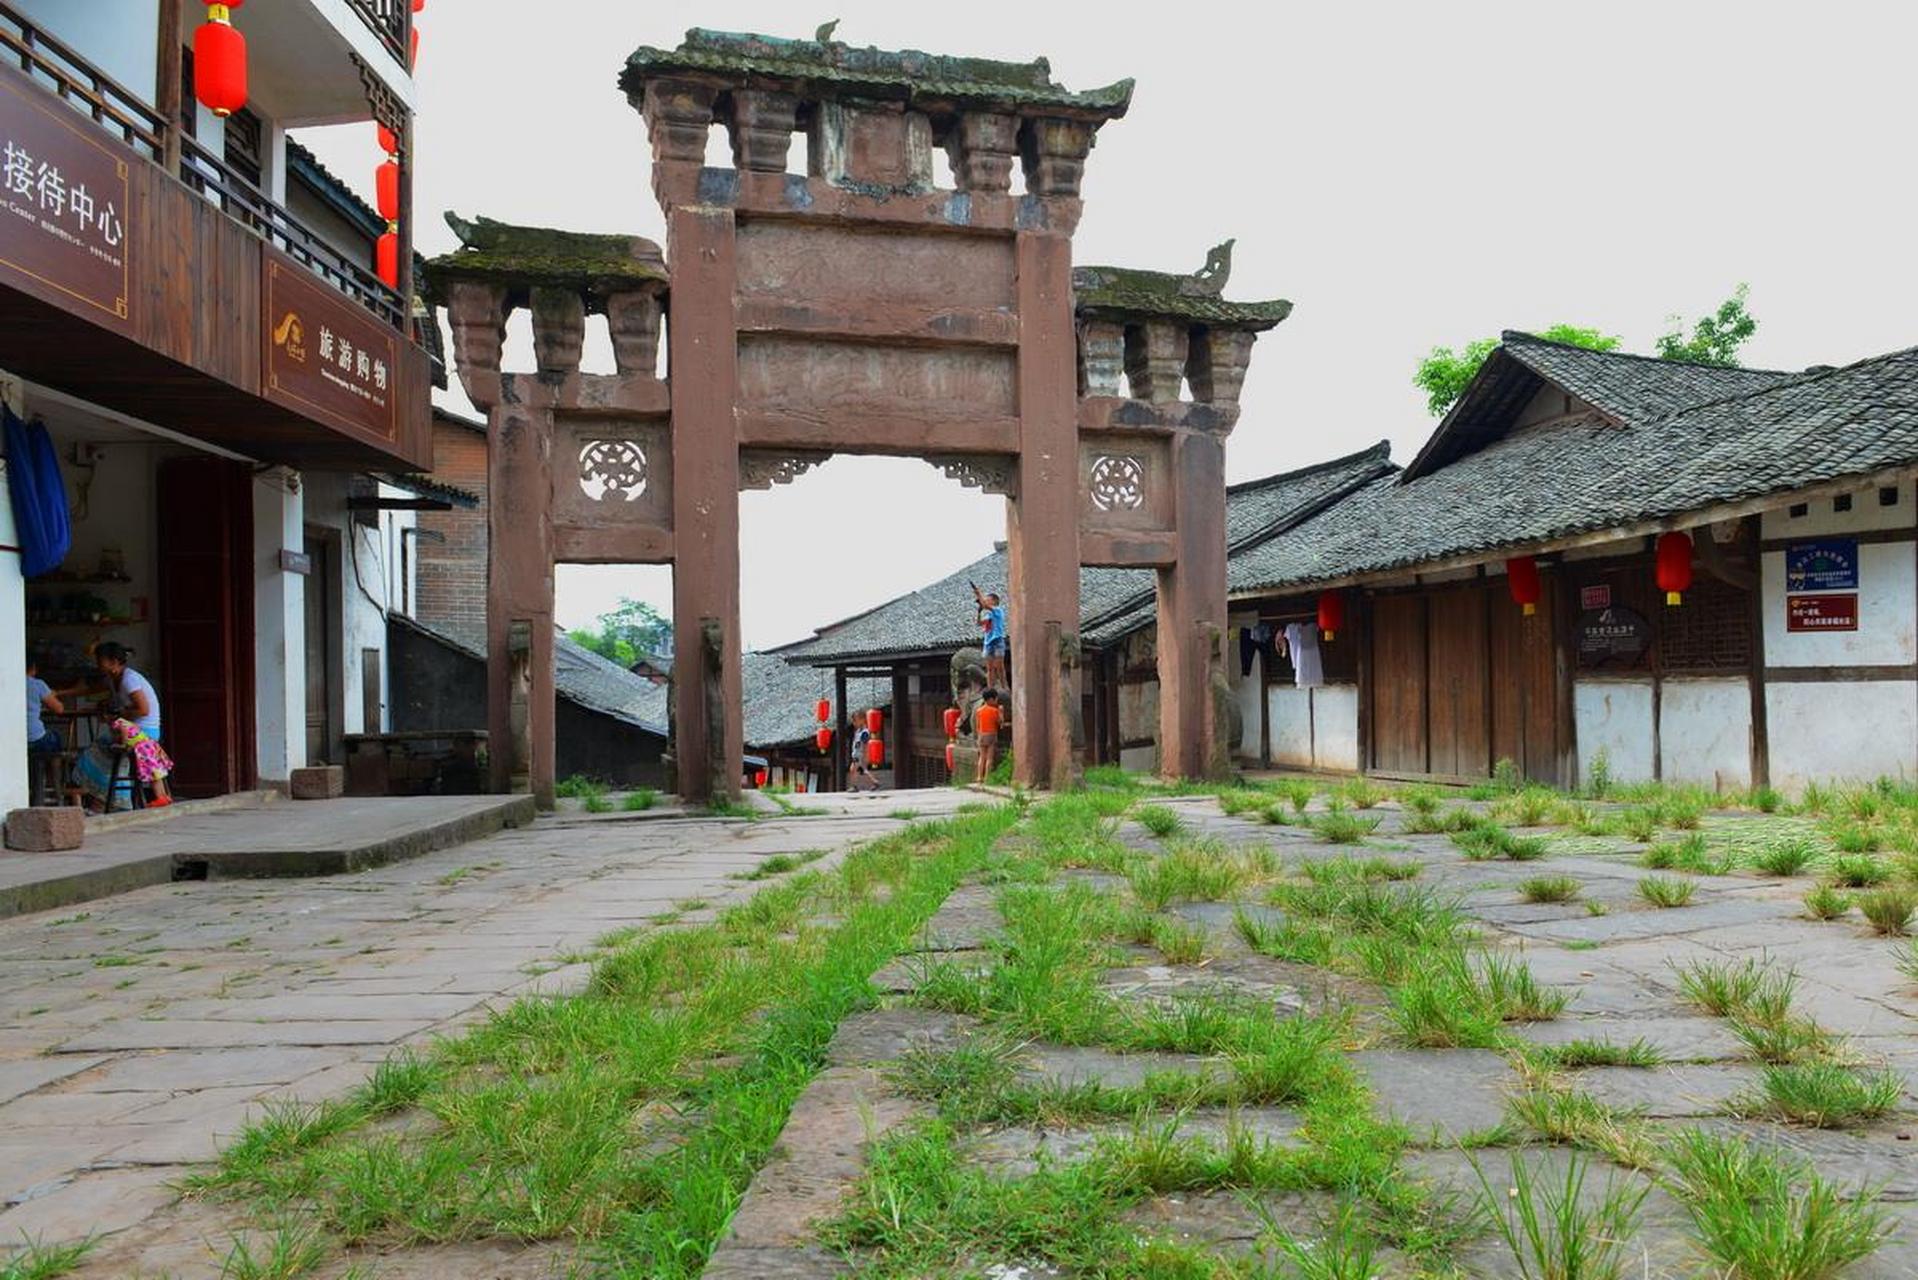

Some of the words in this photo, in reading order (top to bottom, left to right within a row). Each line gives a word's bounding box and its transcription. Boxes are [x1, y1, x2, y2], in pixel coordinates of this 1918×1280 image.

[3, 140, 122, 246] 接待中心
[9, 201, 36, 222] Center
[319, 325, 386, 390] 旅游购物
